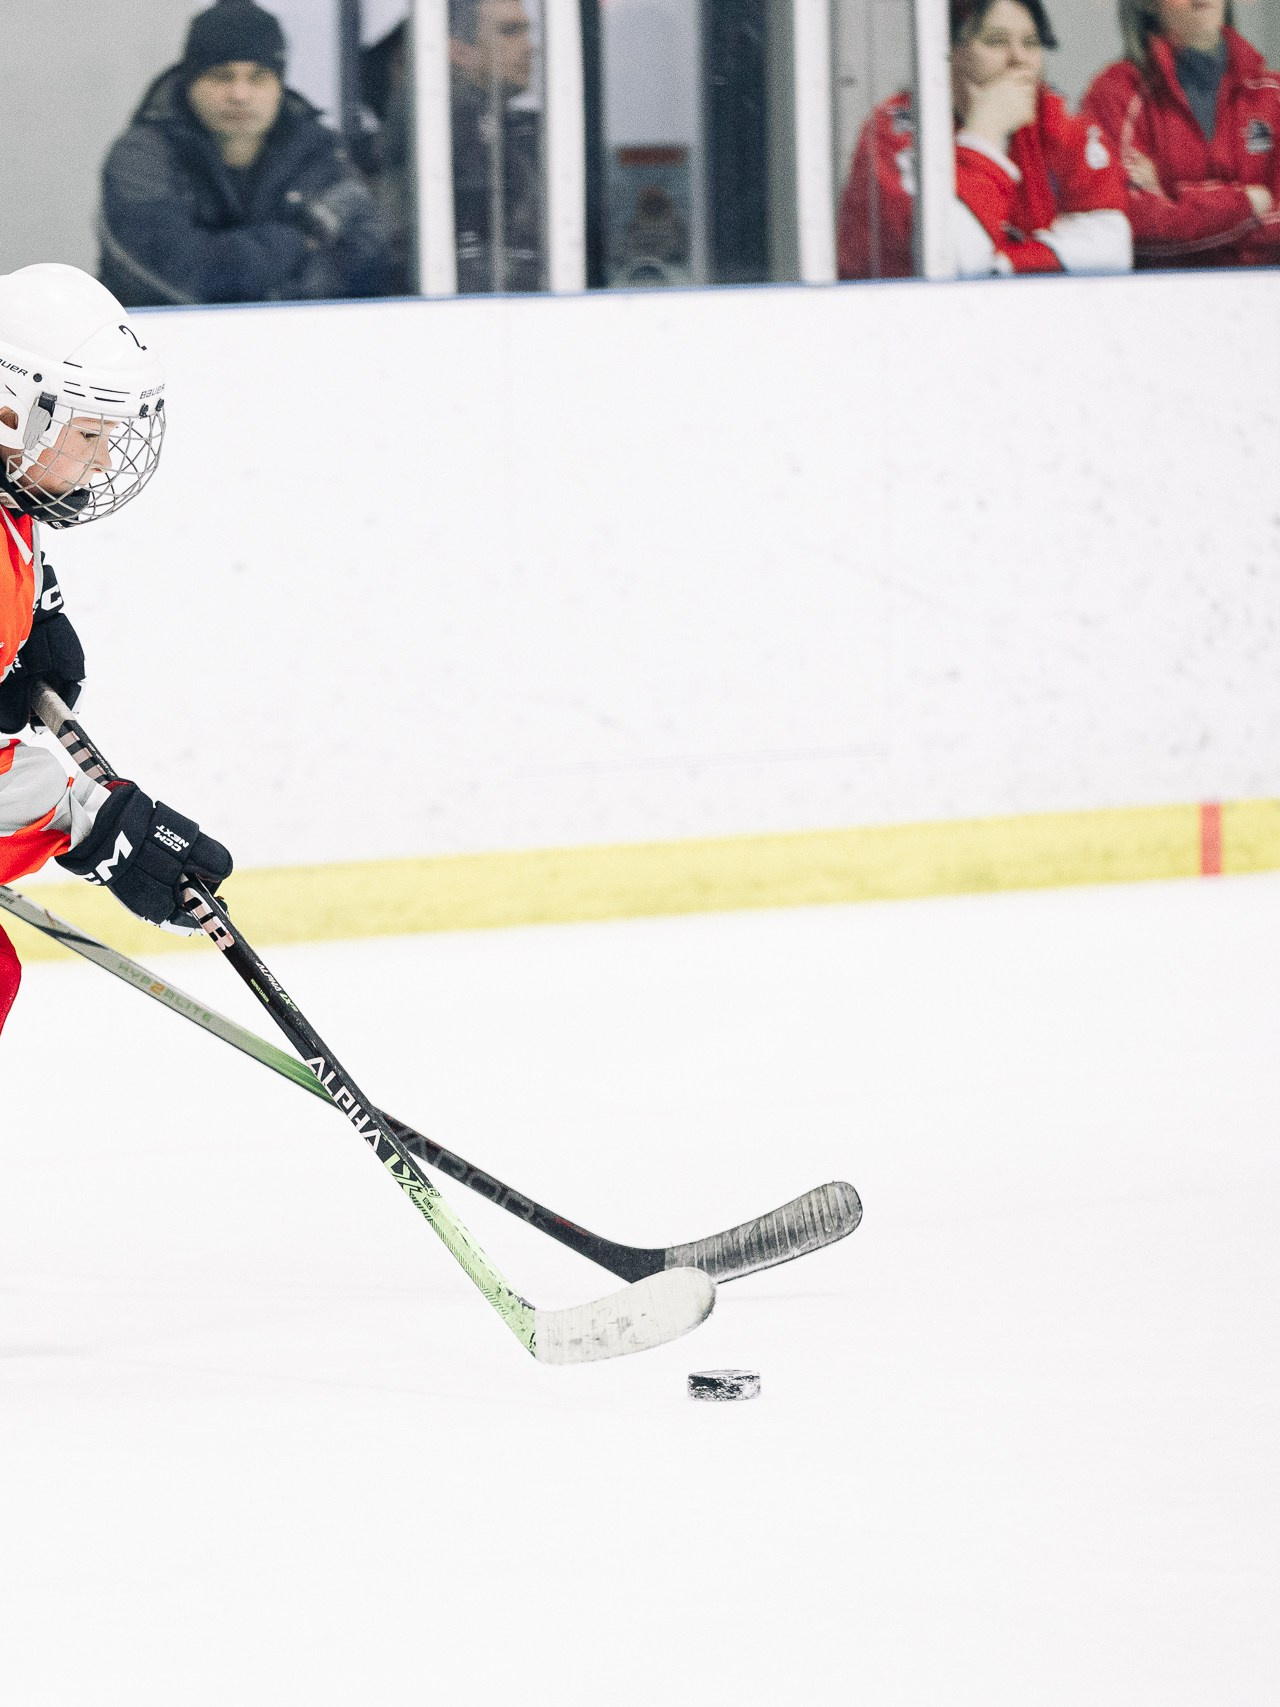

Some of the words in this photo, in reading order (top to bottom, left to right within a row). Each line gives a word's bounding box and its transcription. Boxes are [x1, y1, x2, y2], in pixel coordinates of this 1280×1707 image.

[153, 831, 183, 853] CCM
[155, 824, 190, 849] NEXT
[305, 1056, 382, 1152] ALPHA
